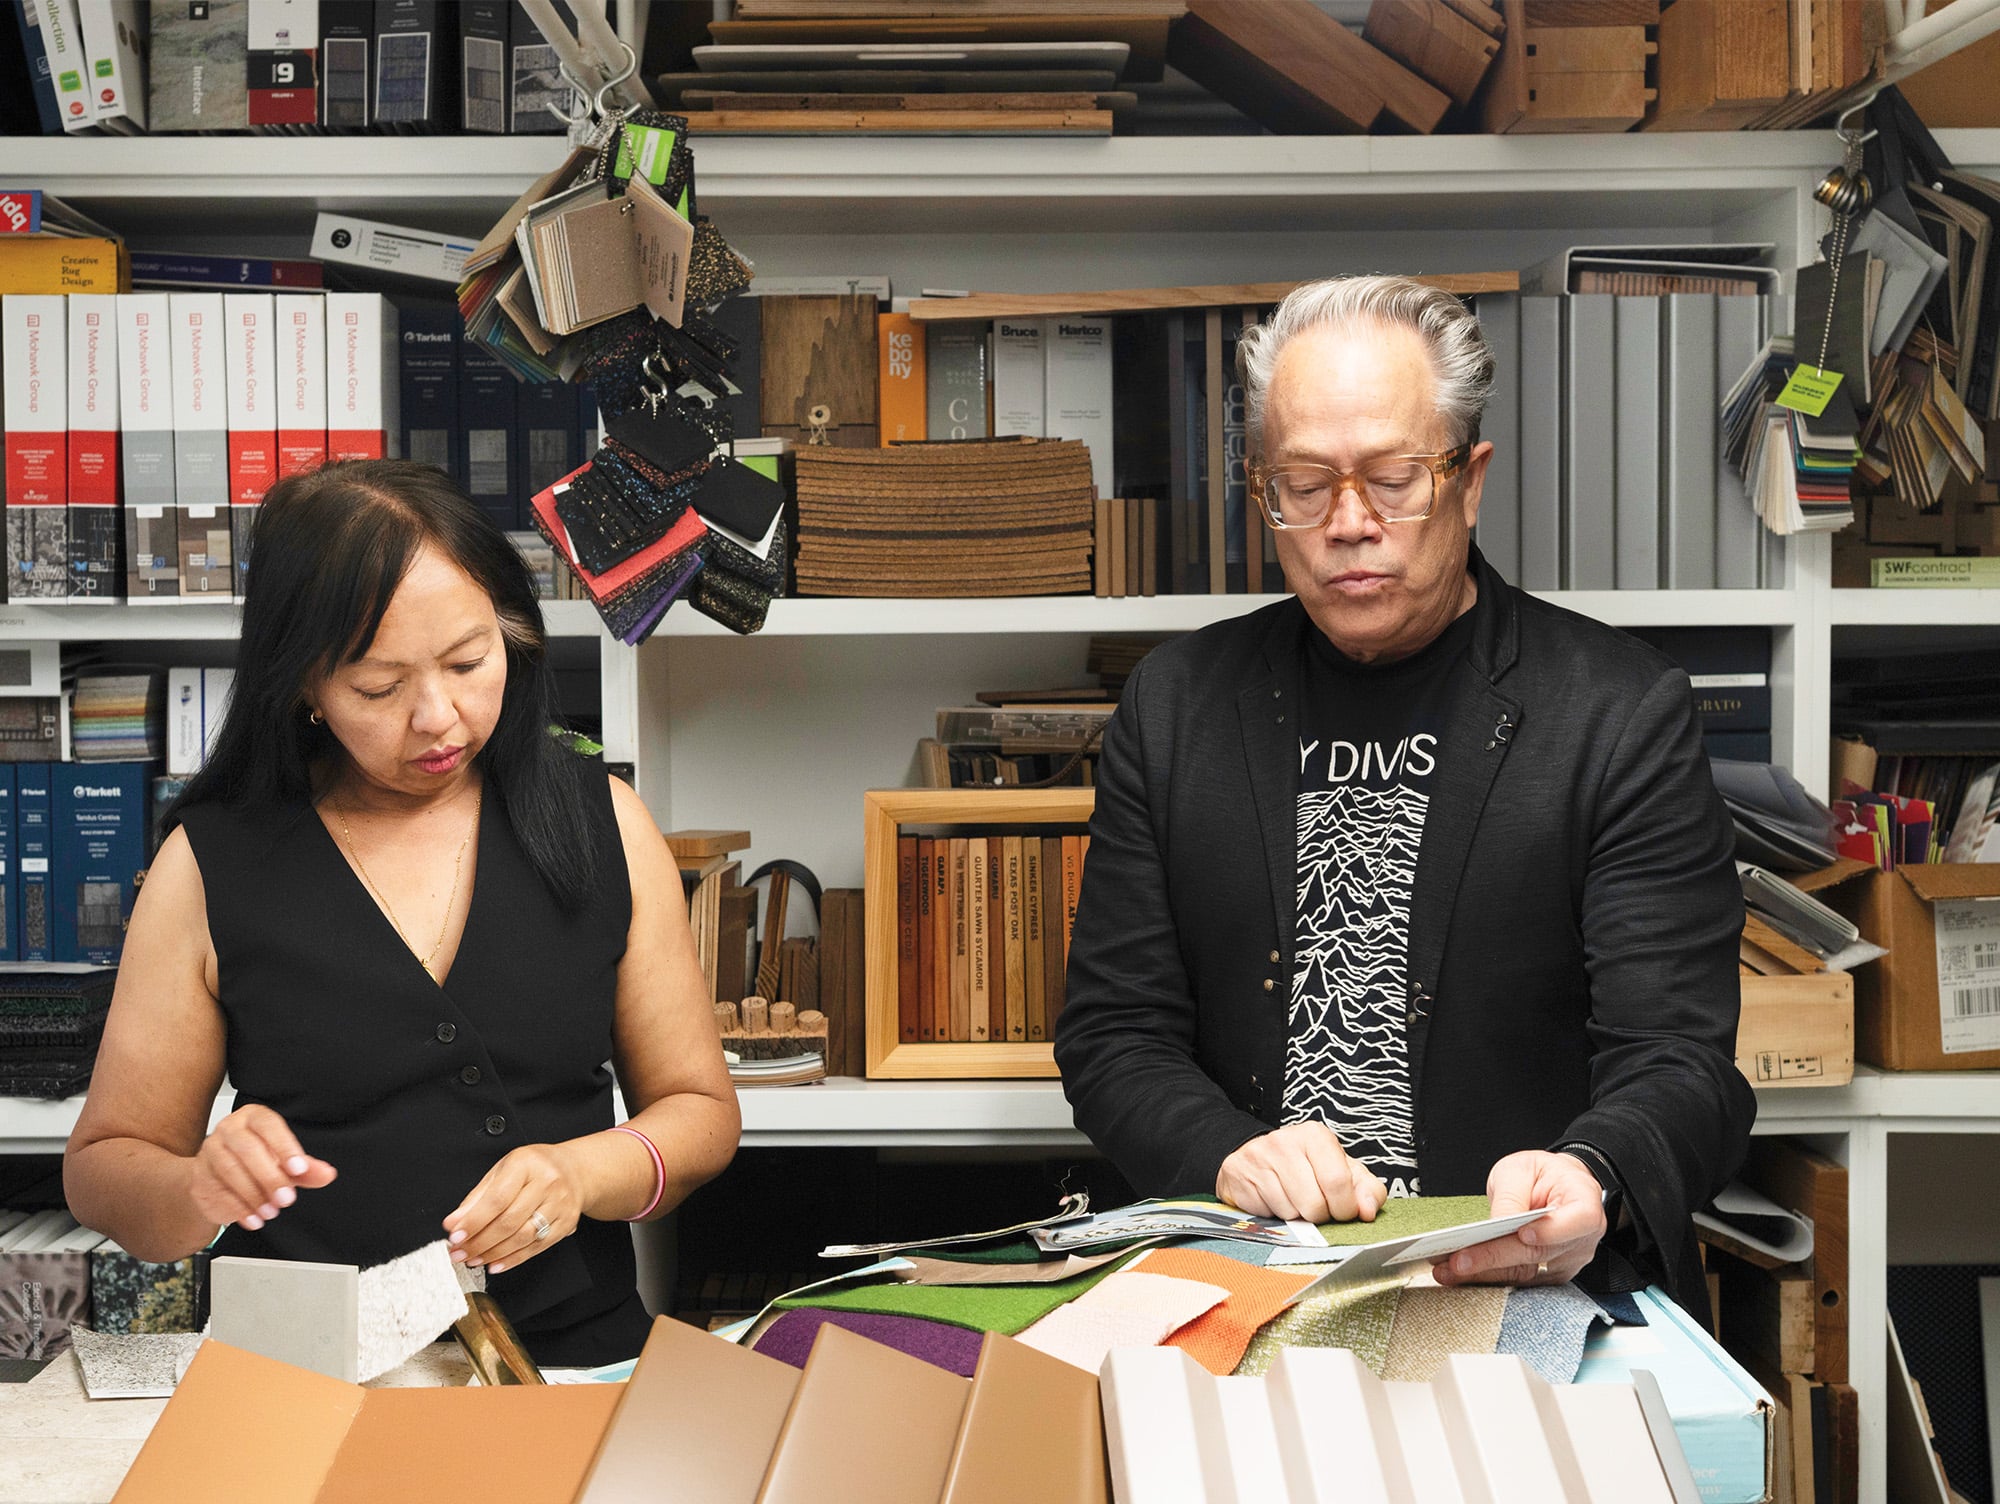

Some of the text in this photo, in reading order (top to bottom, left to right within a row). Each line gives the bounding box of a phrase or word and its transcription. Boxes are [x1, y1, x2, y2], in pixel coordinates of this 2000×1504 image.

[192, 65, 203, 114] Interface
[277, 62, 294, 83] 9
[61, 255, 99, 264] Creative
[61, 266, 80, 276] Rug
[61, 277, 94, 287] Design
[415, 333, 451, 342] Tarkett
[1001, 325, 1039, 337] Bruce
[1058, 324, 1103, 335] Hartco
[29, 330, 39, 376] Mohawk
[88, 329, 98, 375] Mohawk
[139, 329, 149, 376] Mohawk
[192, 329, 202, 376] Mohawk
[245, 329, 255, 376] Mohawk
[296, 328, 306, 374] Mohawk
[347, 328, 357, 375] Mohawk
[28, 379, 40, 413] Group
[86, 378, 98, 412] Group
[138, 378, 150, 412] Group
[192, 378, 203, 411] Group
[245, 378, 257, 412] Group
[296, 377, 307, 410] Group
[347, 377, 358, 411] Group
[1884, 561, 1972, 574] SWFcontract
[84, 787, 121, 797] Tarkett
[921, 856, 929, 915] TIGERWOOD
[991, 856, 999, 900] CUMARU
[1067, 872, 1075, 917] DOUGLAS
[1009, 856, 1019, 941] TEXAS POST OAK
[974, 856, 983, 992] QUARTER SAWN SYCAMORE
[1030, 896, 1038, 941] CYPRESS
[32, 1282, 41, 1311] Etched
